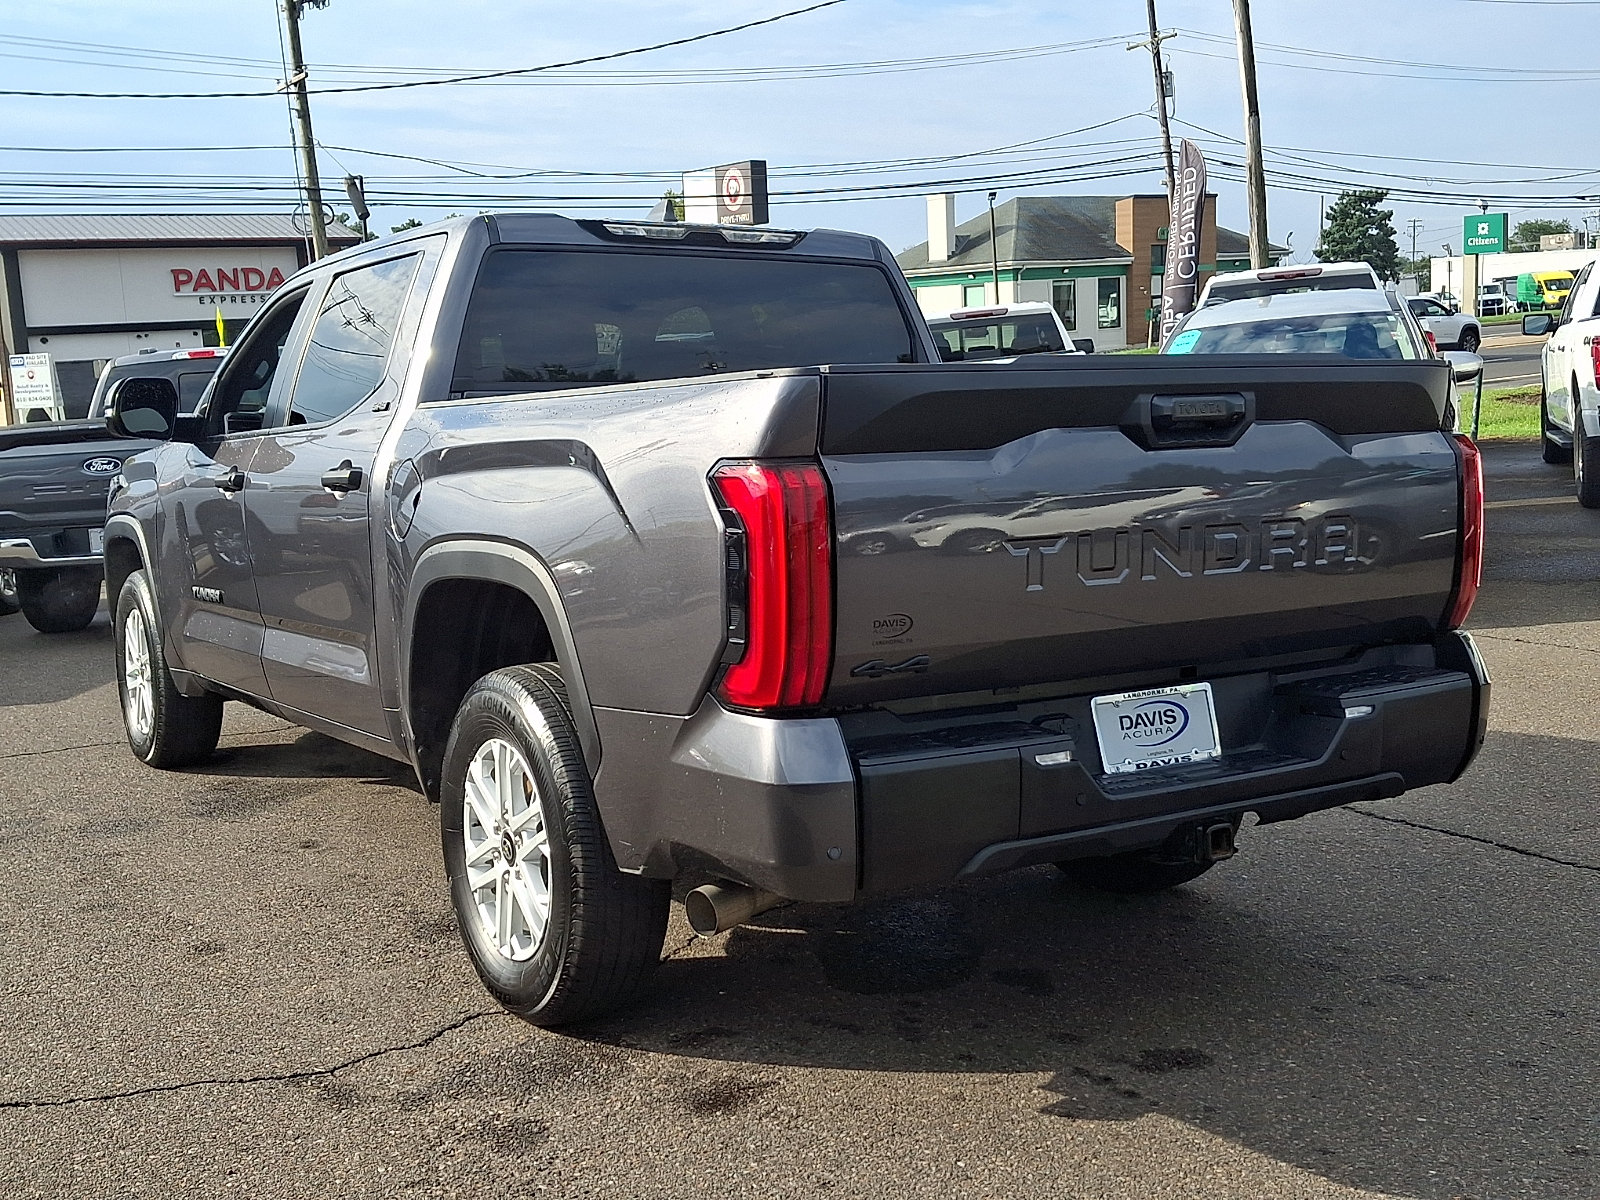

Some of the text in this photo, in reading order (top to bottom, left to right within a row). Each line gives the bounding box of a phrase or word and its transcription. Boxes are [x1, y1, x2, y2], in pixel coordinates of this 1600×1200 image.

[720, 213, 749, 223] DRIVE-THRU
[1467, 237, 1499, 246] Citizens
[170, 267, 285, 292] PANDA
[198, 295, 266, 304] EXPRESS
[1179, 403, 1223, 414] TOYOTA
[90, 460, 115, 471] Ford
[1002, 515, 1358, 592] TUNDRA
[191, 585, 225, 604] TUNDRA
[873, 618, 907, 629] DAVIS
[1118, 708, 1177, 731] DAVIS
[1122, 726, 1174, 741] ACURA
[1135, 755, 1192, 770] DAVIS
